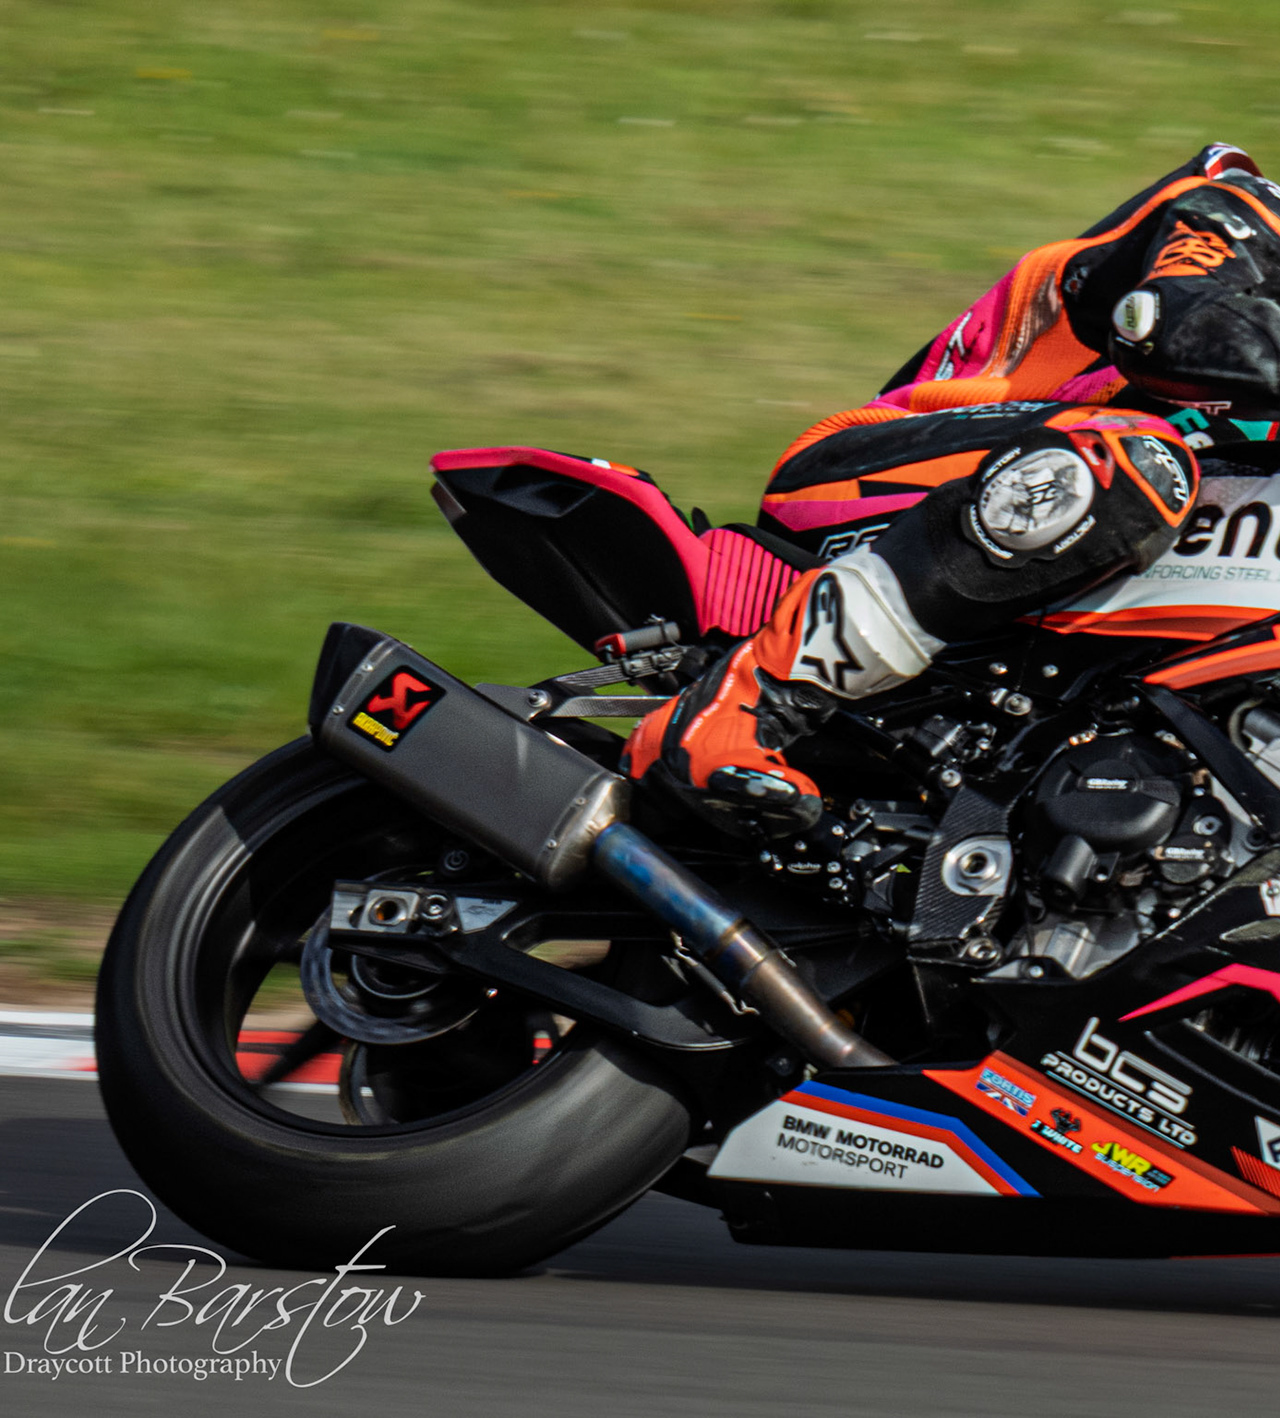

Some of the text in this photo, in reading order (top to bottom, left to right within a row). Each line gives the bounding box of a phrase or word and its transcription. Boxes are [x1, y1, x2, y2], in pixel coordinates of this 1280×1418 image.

[1039, 1052, 1199, 1146] PRODUCTS LTD
[776, 1132, 909, 1179] MOTORSPORT
[782, 1114, 945, 1169] BMW MOTORRAD
[1041, 1125, 1083, 1154] WHITE
[1090, 1141, 1152, 1177] JWR
